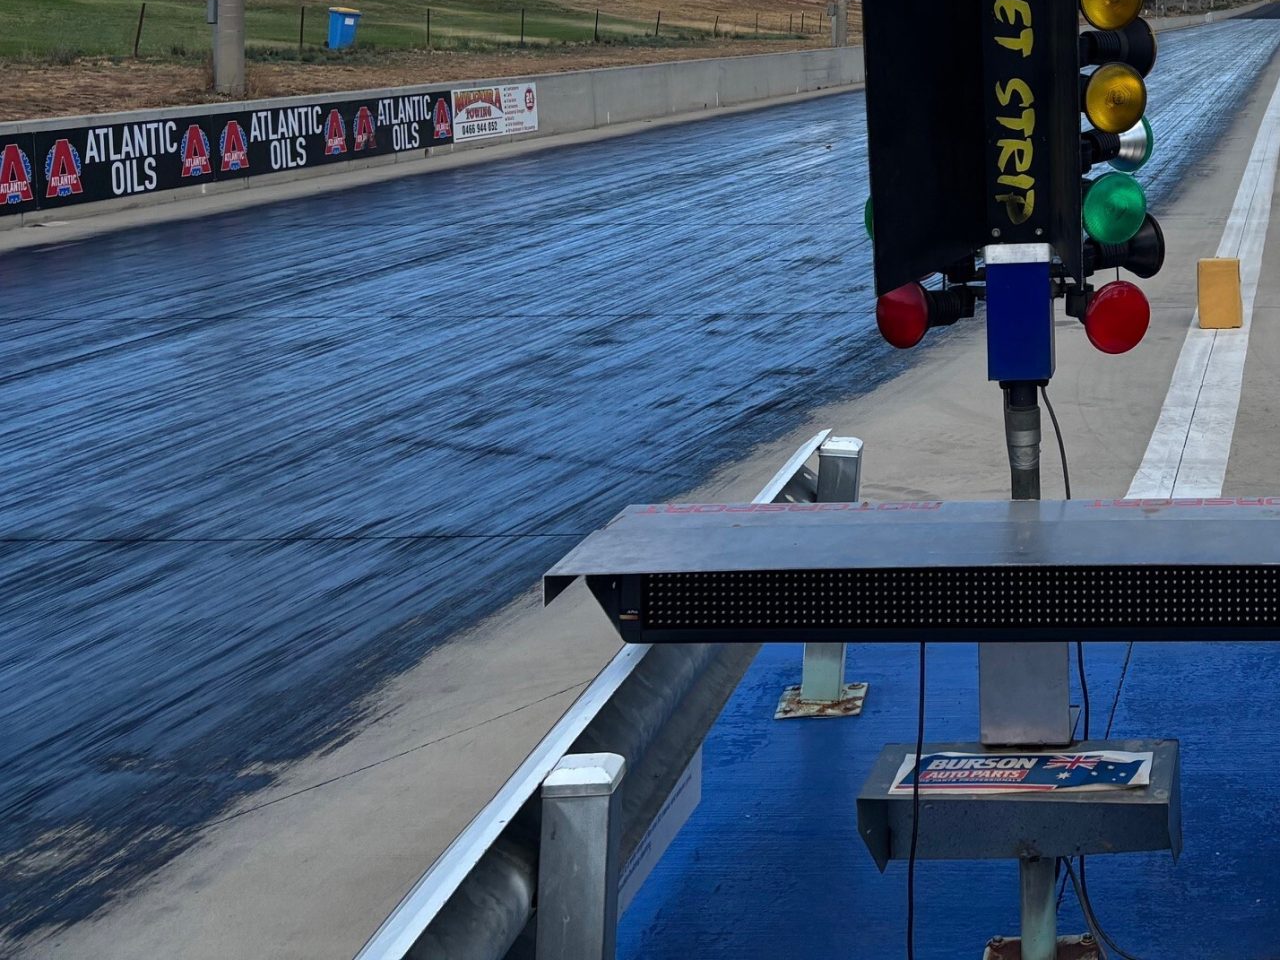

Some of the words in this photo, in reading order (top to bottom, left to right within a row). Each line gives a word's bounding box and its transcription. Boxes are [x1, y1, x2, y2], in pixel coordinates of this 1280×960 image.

[250, 106, 322, 142] ATLANTIC
[377, 95, 431, 127] ATLANTIC
[465, 106, 491, 120] TOWING
[85, 121, 177, 165] ATLANTIC
[392, 122, 420, 151] OILS
[995, 78, 1035, 226] STRIP
[270, 137, 307, 170] OILS
[51, 174, 78, 187] ATLANTIC
[111, 157, 157, 195] OILS
[926, 770, 966, 779] AUTO
[969, 769, 1021, 779] PARTS
[927, 758, 1038, 770] BURSON
